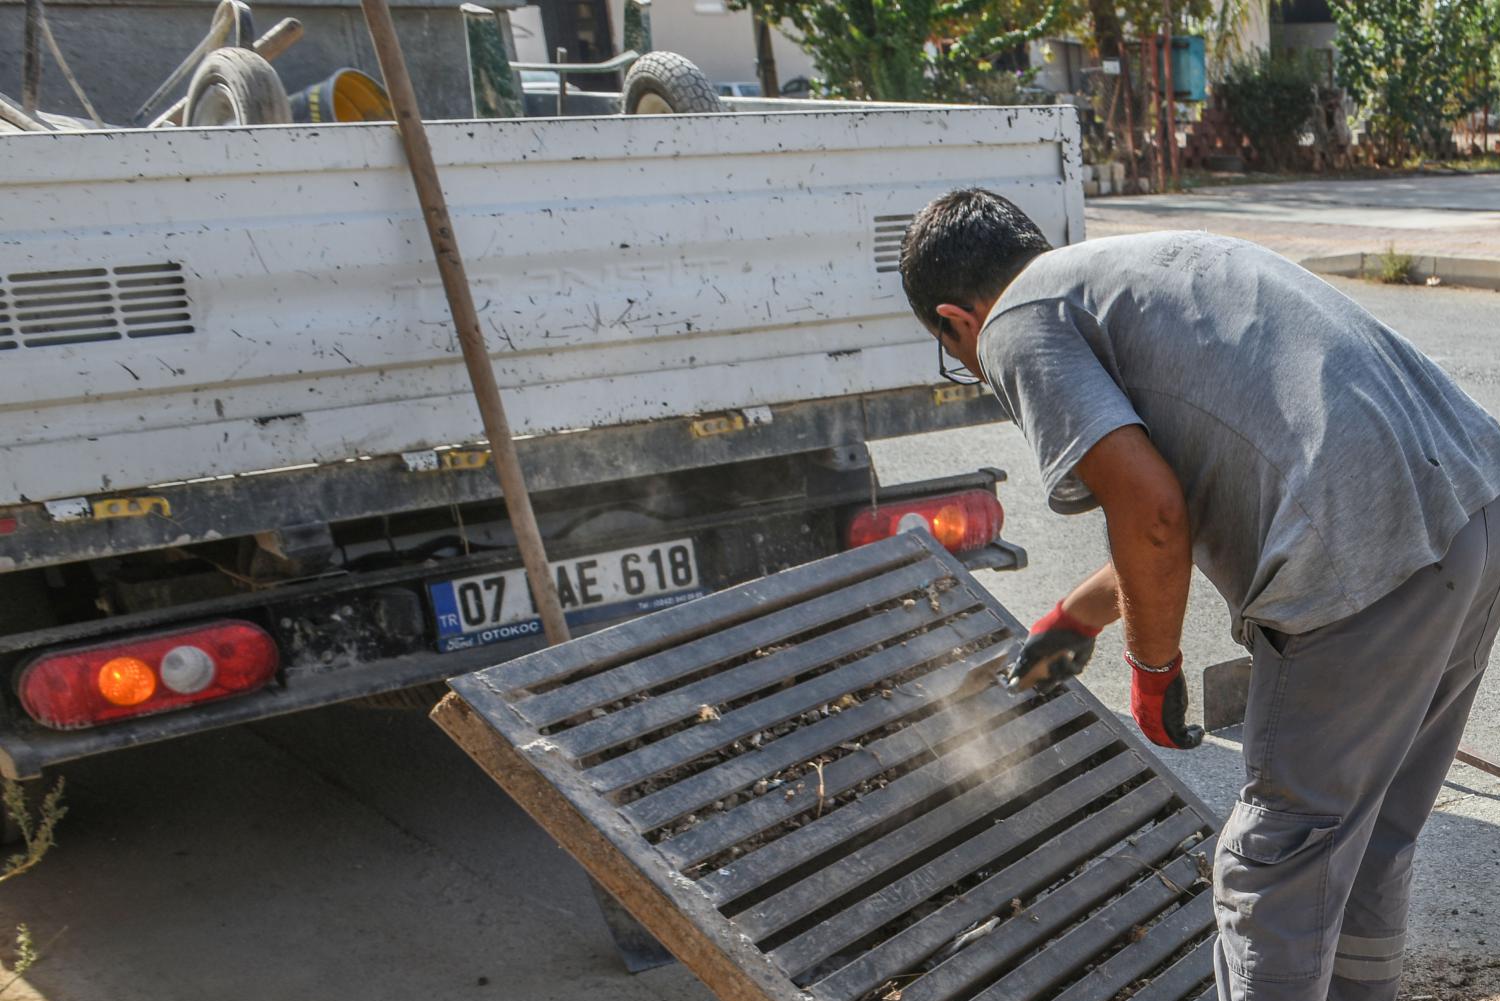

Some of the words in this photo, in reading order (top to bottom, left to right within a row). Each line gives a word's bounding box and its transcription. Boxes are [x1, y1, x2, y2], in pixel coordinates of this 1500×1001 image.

[457, 575, 507, 627] 07
[620, 545, 694, 596] 618
[439, 612, 459, 628] TR
[482, 621, 539, 642] OTOKOÇ
